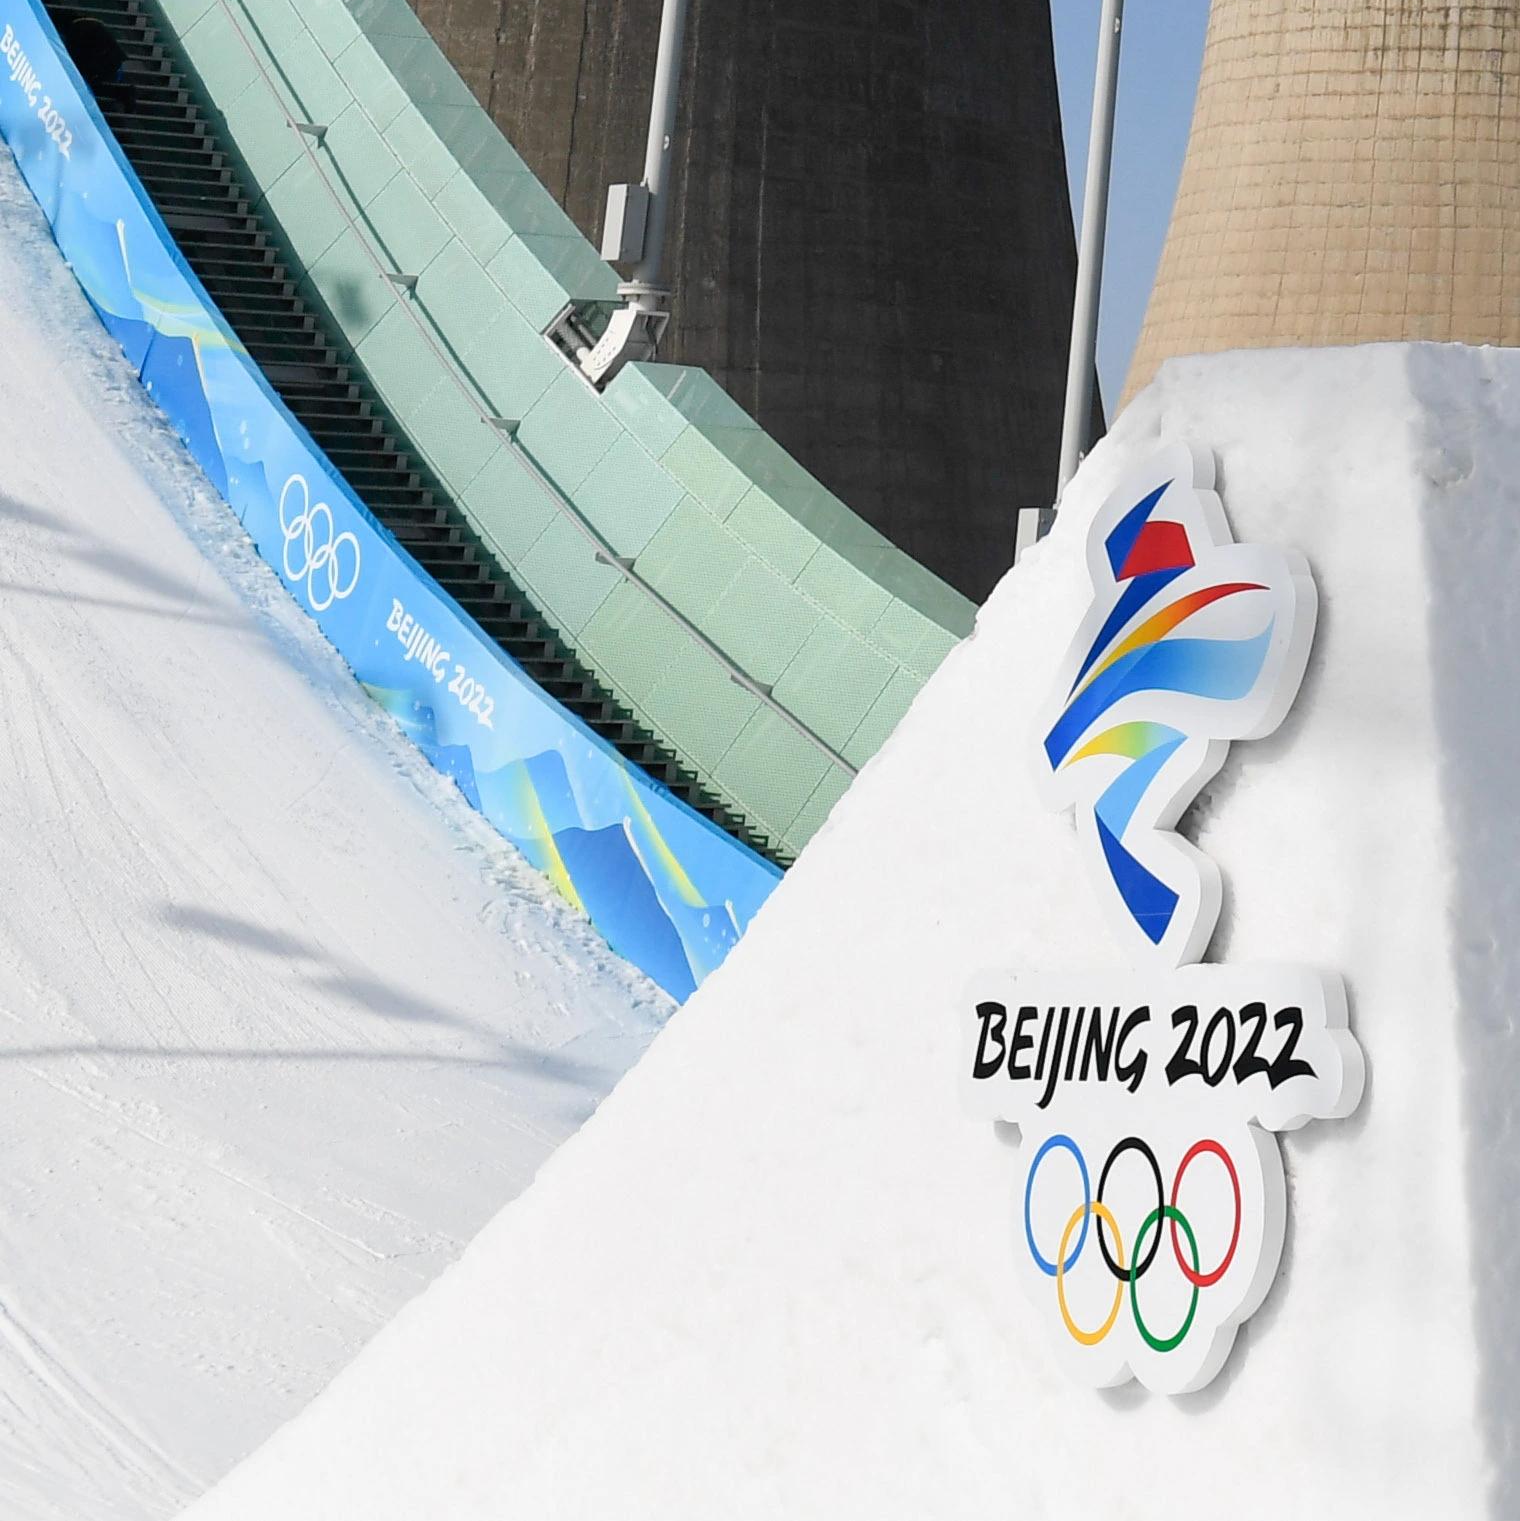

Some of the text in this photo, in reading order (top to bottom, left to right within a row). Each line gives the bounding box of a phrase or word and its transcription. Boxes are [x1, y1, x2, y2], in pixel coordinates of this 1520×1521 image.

[0, 23, 73, 161] BEIJING 2022
[386, 597, 496, 734] BEIJING 2022
[972, 1001, 1320, 1110] BEIJING 2022
